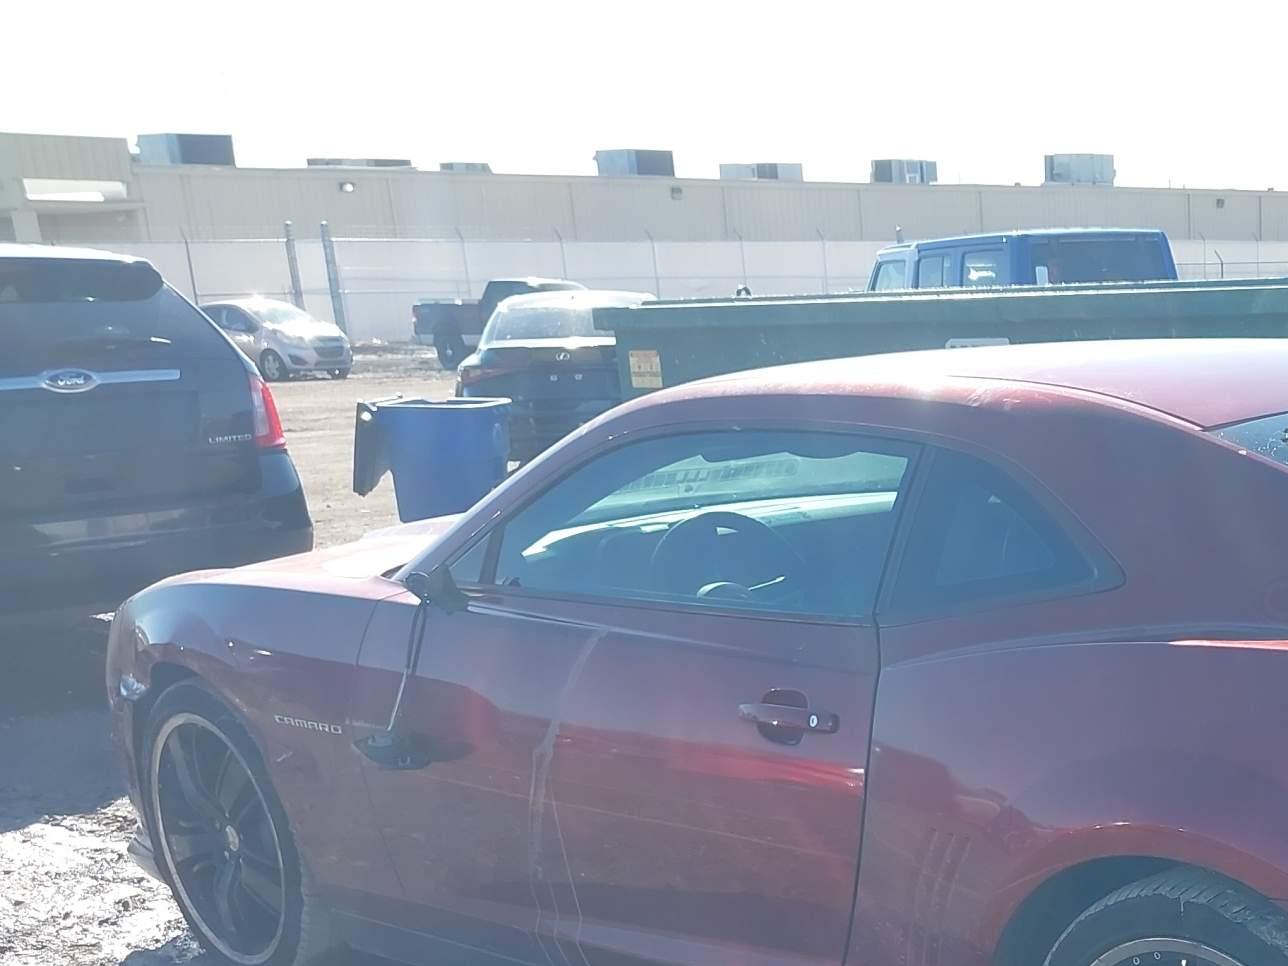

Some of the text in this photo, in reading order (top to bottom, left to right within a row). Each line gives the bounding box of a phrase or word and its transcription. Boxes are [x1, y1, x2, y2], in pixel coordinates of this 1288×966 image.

[57, 375, 85, 386] Ford
[208, 433, 253, 444] LIMITED
[273, 714, 343, 735] CAMARO
